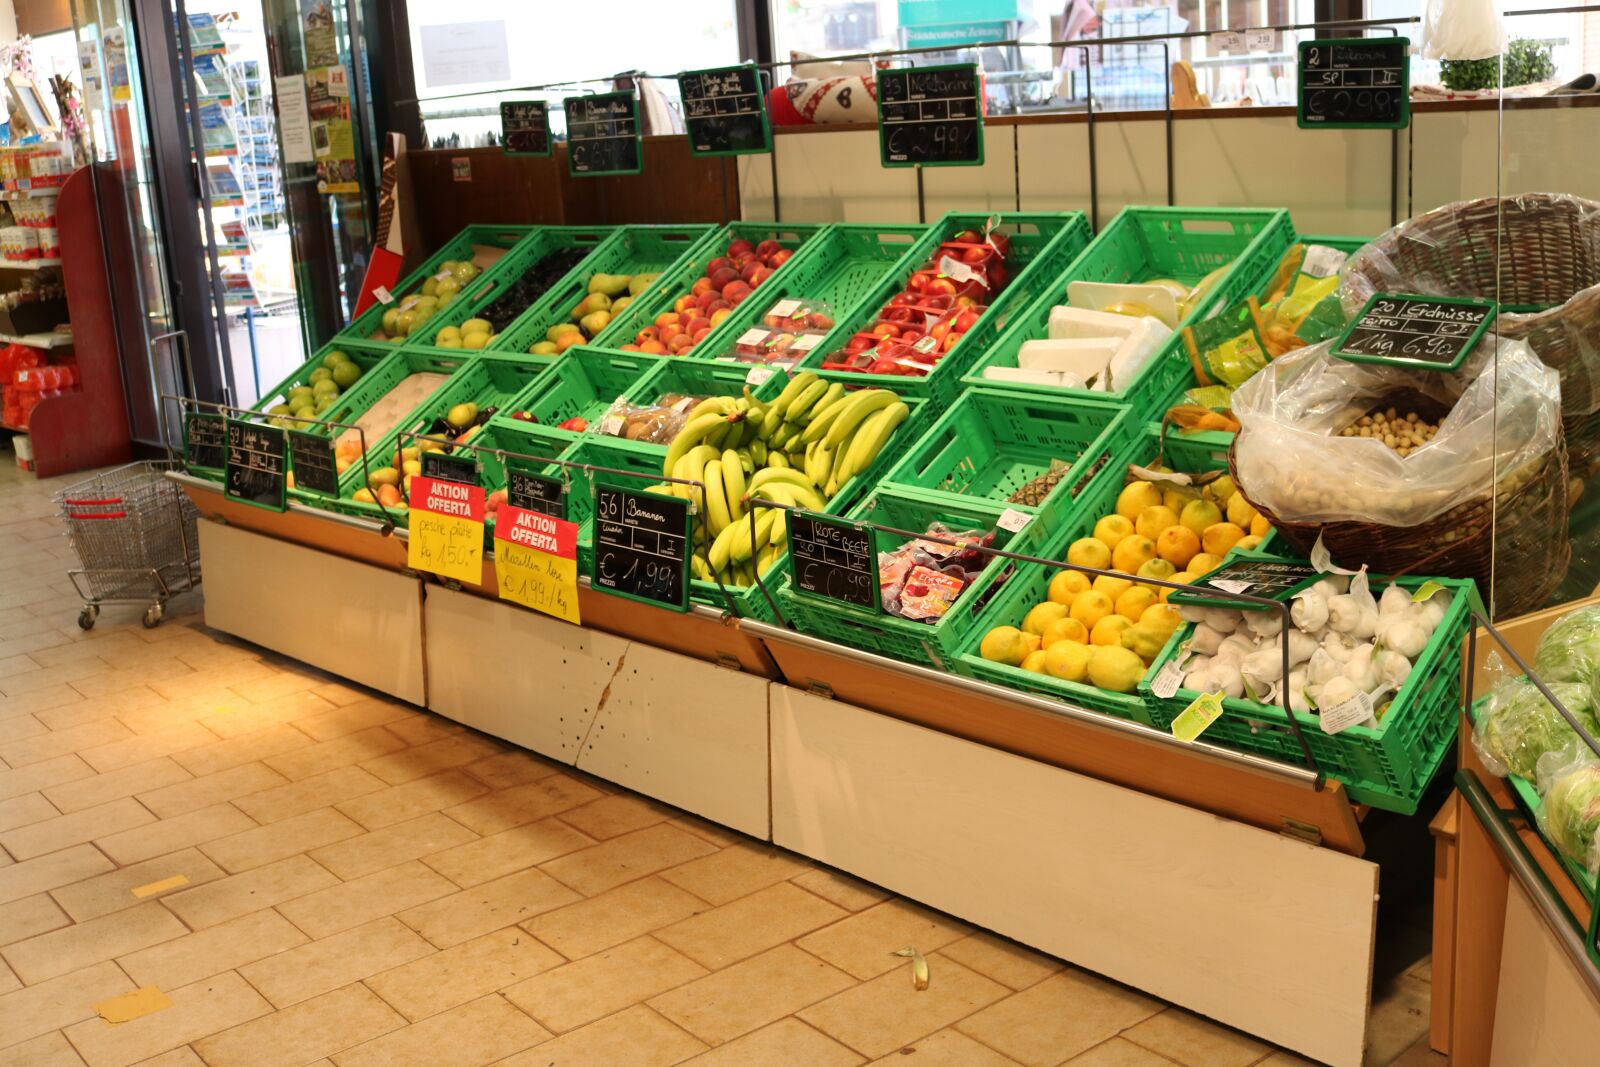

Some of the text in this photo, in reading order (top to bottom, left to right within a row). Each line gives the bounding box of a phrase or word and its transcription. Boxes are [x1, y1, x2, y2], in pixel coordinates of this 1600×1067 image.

[430, 482, 469, 501] AKTION
[427, 496, 472, 517] OFFERTA
[600, 494, 665, 523] 56 Bananen
[515, 512, 557, 534] AKTION
[815, 521, 841, 541] ROTE
[510, 527, 558, 553] OFFERTA
[599, 552, 616, 579] €
[599, 577, 616, 587] PREZZO
